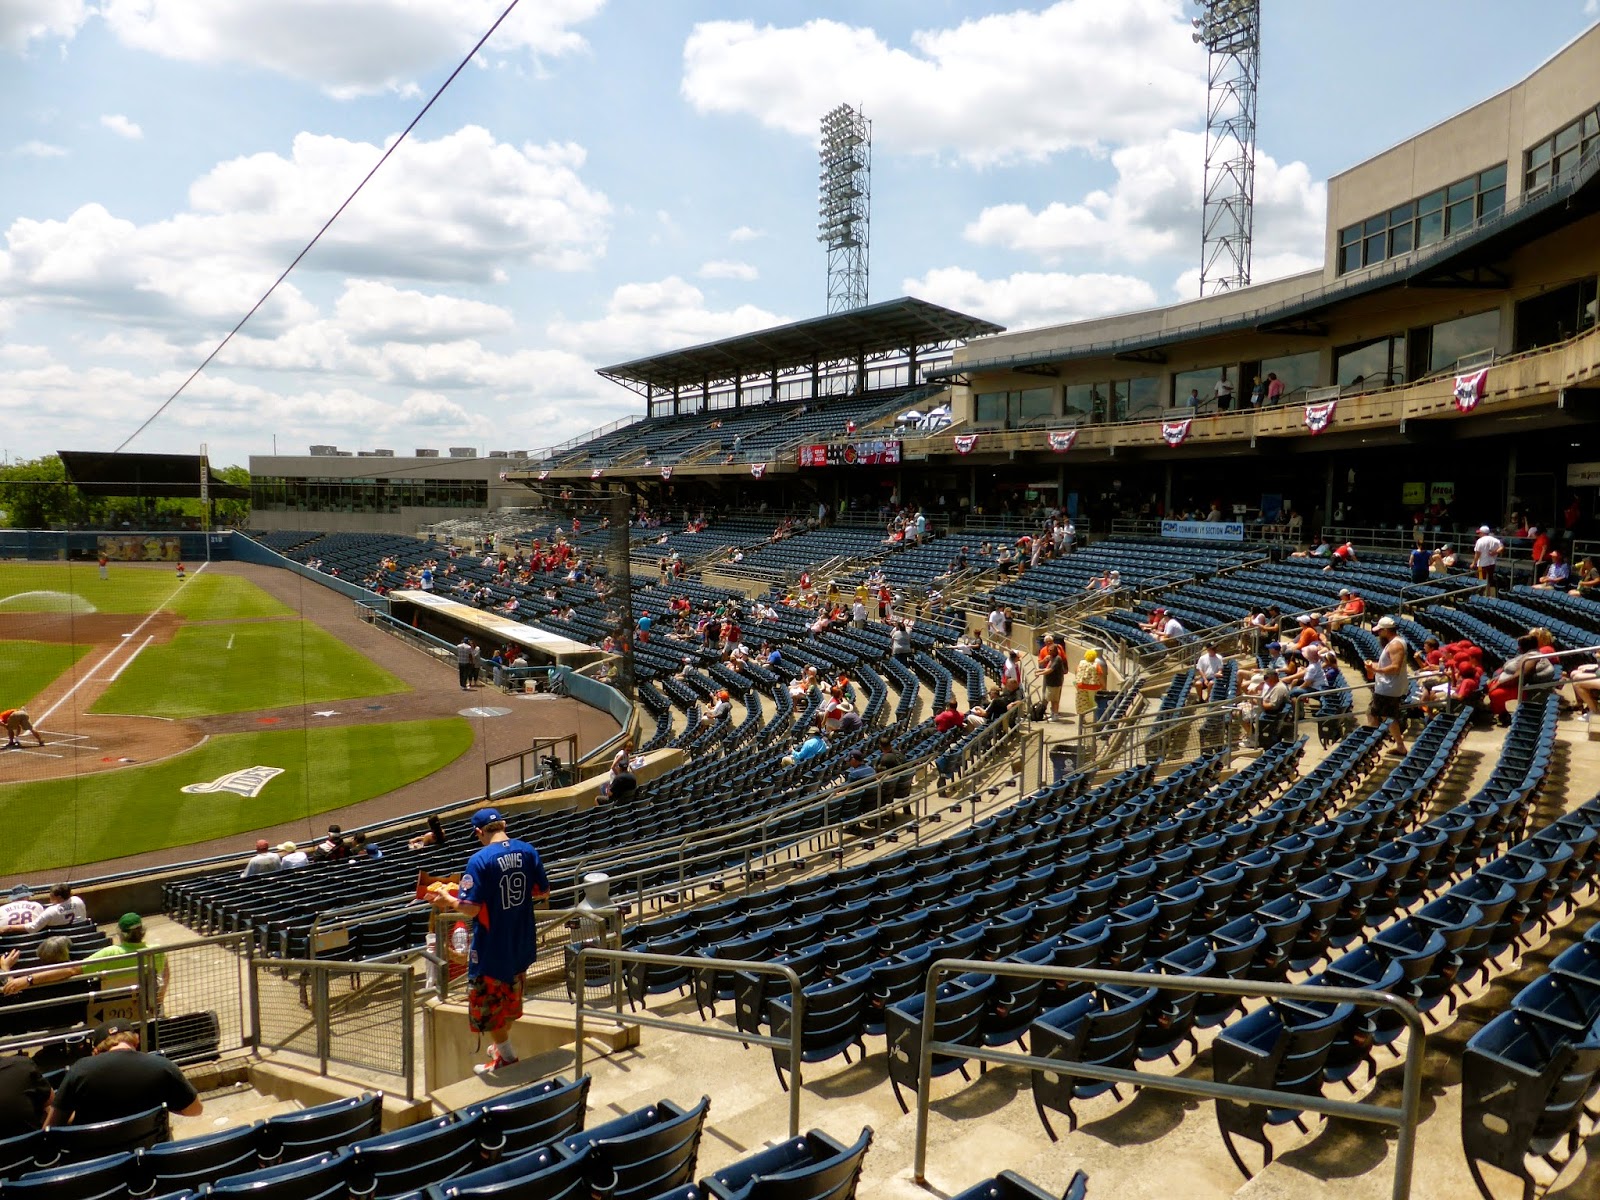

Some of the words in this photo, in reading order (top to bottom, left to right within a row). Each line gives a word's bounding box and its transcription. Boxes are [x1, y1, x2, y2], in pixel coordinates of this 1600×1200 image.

[1178, 525, 1205, 534] COMMUNITY
[1205, 526, 1224, 535] SECTION
[497, 852, 523, 872] DAVIS
[499, 871, 526, 910] 19
[8, 911, 33, 926] 28
[65, 912, 75, 925] 7
[109, 1007, 133, 1020] 203
